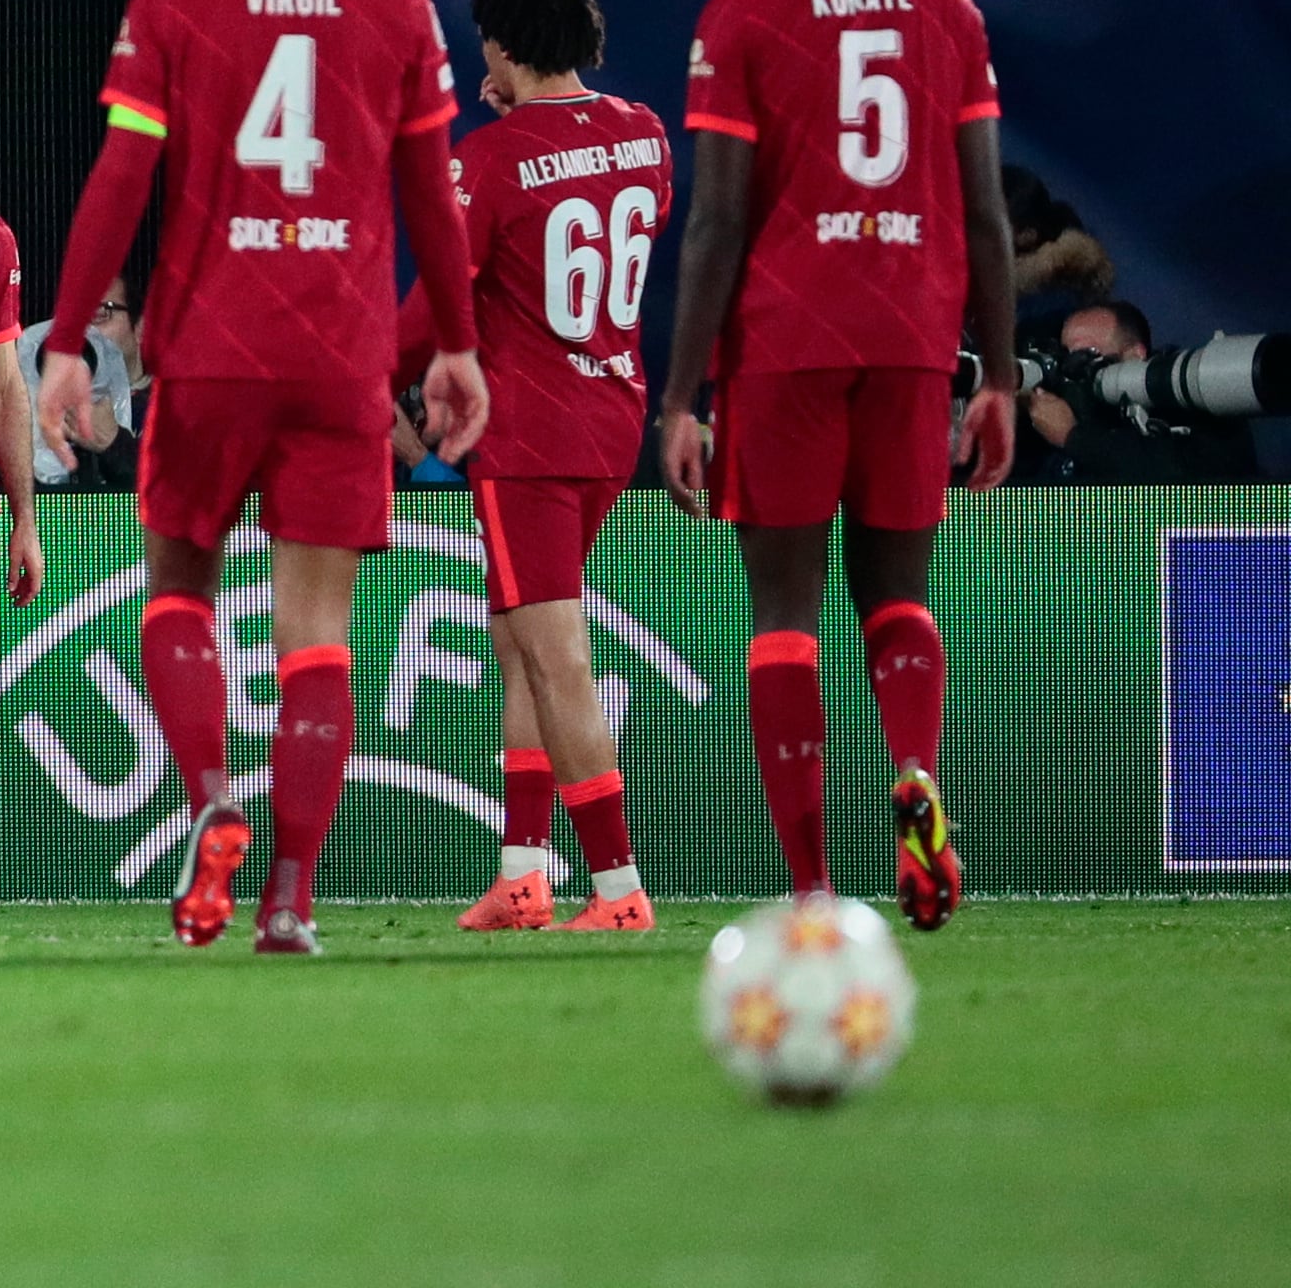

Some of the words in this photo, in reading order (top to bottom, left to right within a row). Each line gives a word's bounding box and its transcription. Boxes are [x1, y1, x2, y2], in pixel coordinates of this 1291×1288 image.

[235, 34, 324, 194] 4
[518, 137, 662, 190] ALEXANDER-ARNOLD
[838, 29, 910, 188] 5
[228, 216, 282, 251] SIDE
[297, 216, 351, 251] SIDE
[544, 185, 656, 343] 66
